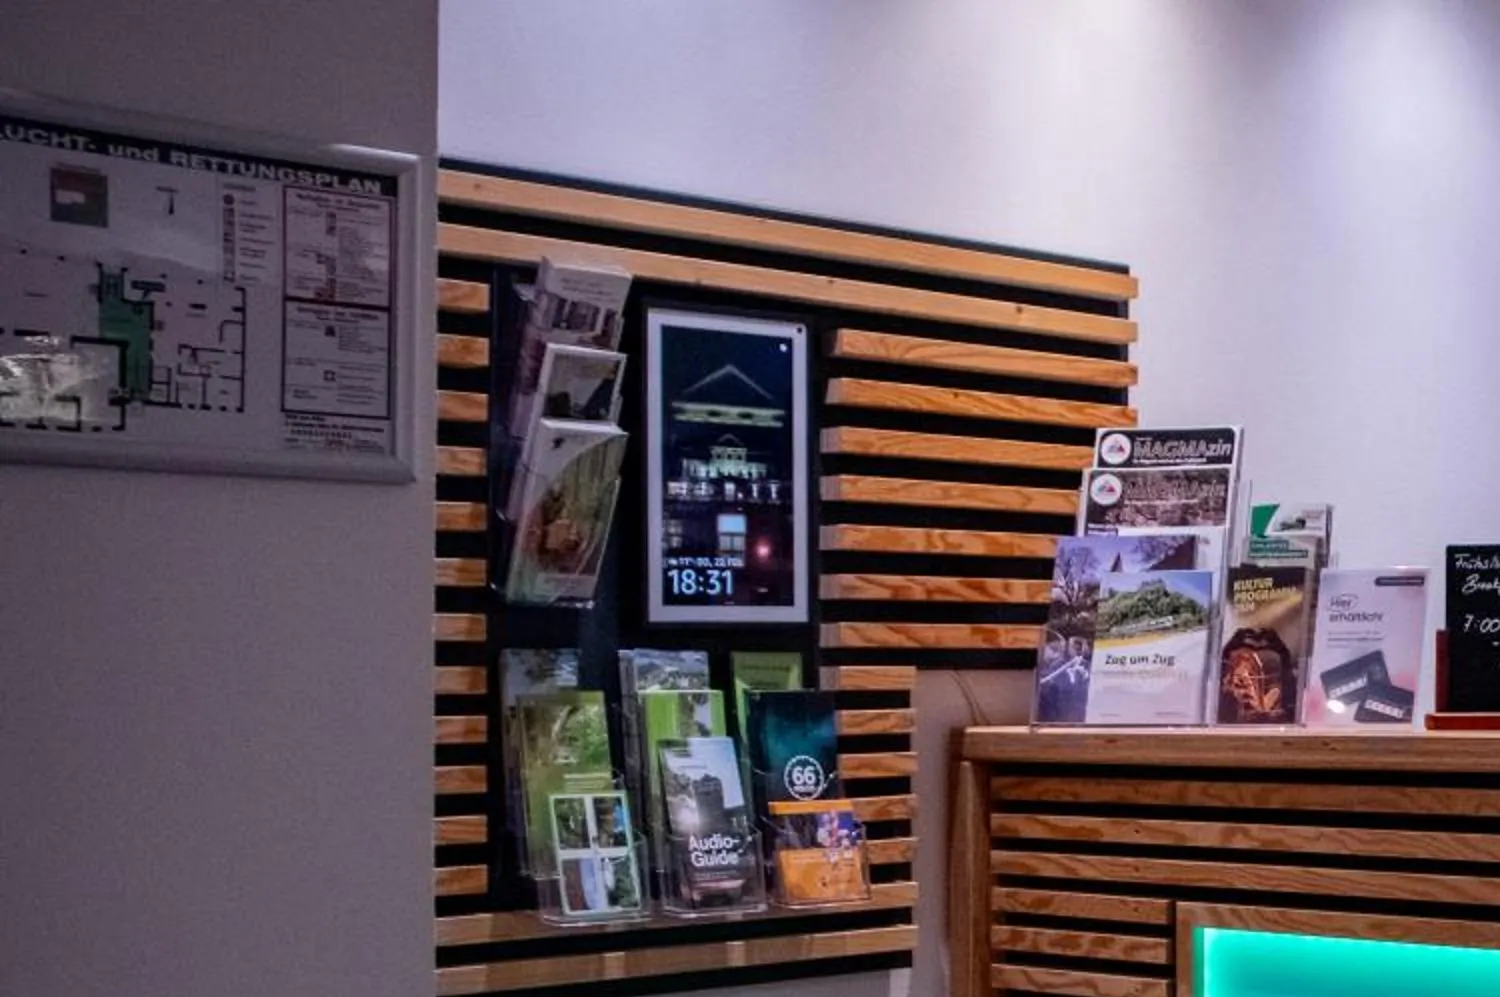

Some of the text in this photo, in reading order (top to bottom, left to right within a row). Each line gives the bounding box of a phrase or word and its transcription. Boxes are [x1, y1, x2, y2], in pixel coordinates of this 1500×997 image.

[0, 123, 382, 195] UCHT- und RETTUNGSPLAN
[667, 569, 734, 595] 18:31
[1105, 653, 1176, 666] Zug um Zug
[792, 765, 816, 785] 66
[688, 833, 740, 851] Audio-
[691, 850, 739, 867] Guide
